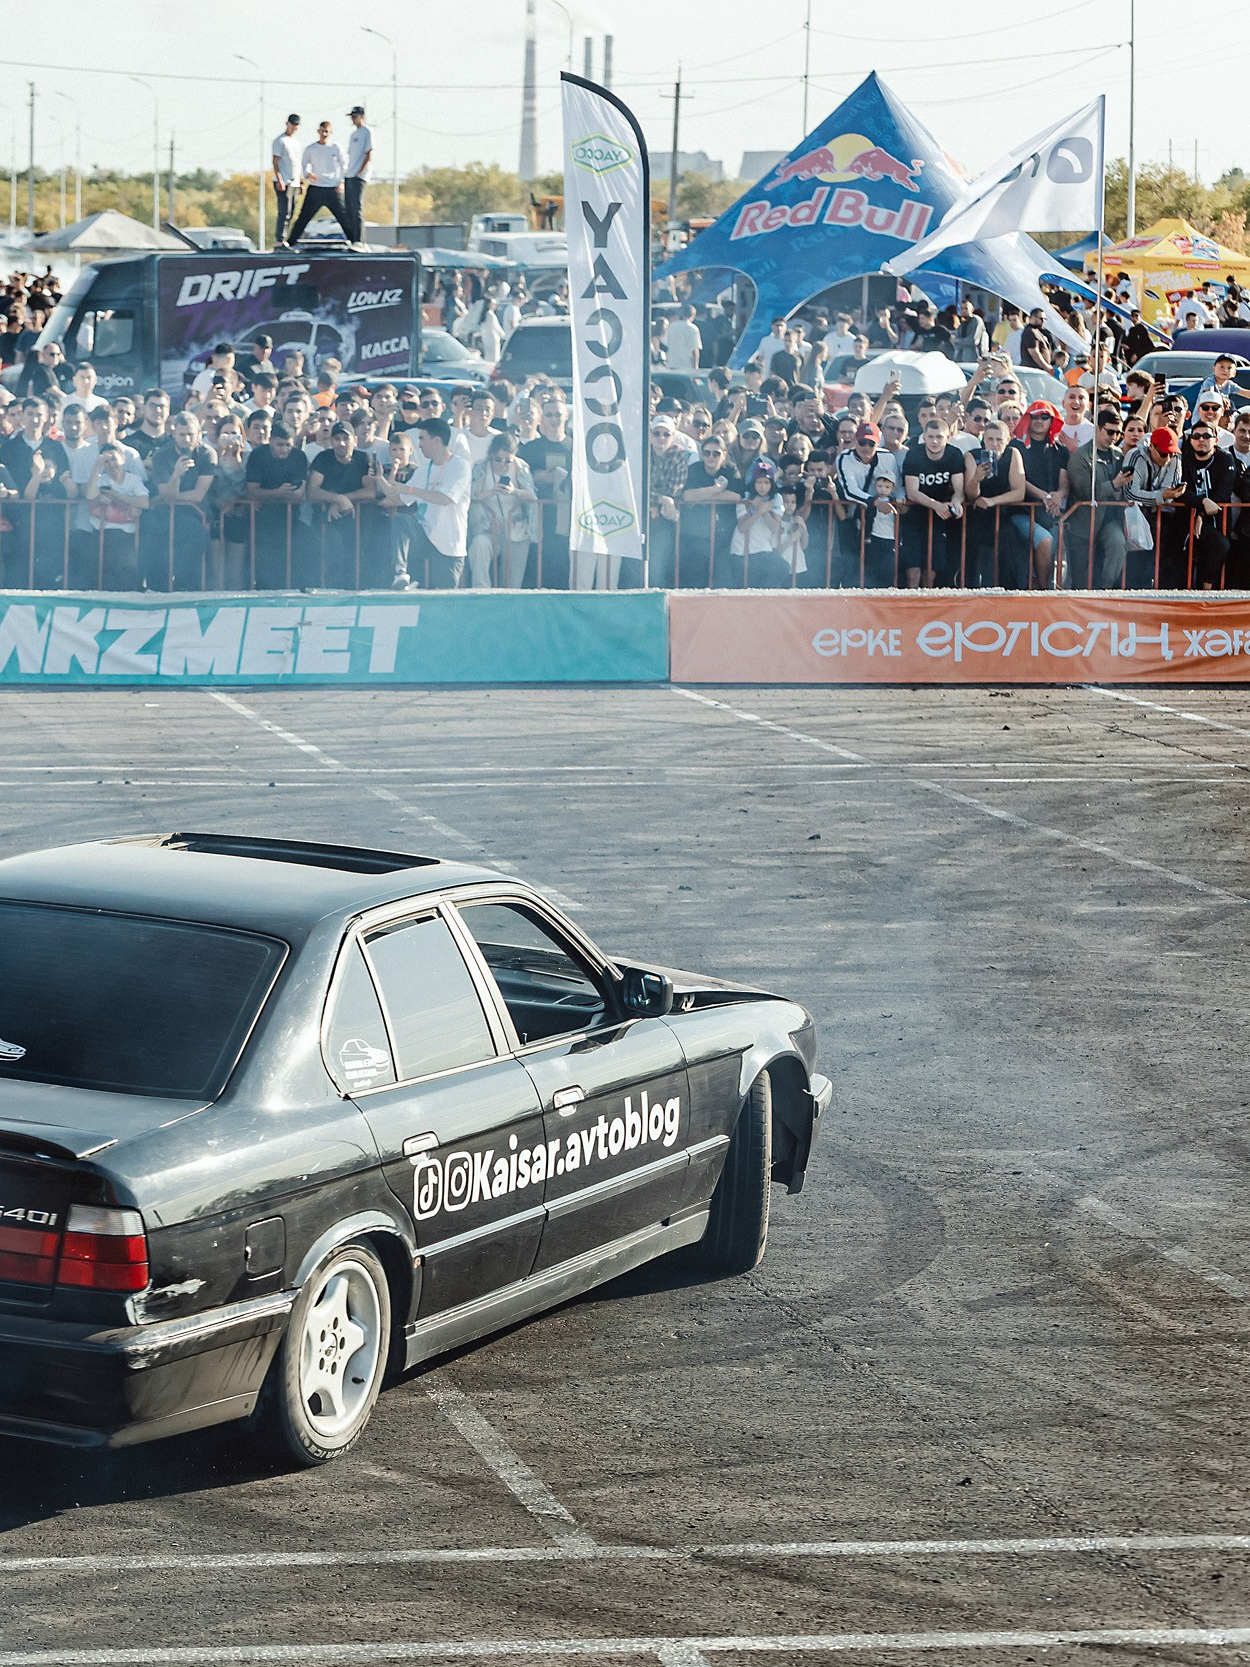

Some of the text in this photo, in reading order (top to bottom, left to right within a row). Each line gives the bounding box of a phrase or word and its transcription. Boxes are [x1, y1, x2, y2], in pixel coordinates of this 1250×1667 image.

[729, 187, 830, 240] Red
[823, 188, 934, 243] Bull
[176, 264, 310, 307] DRIFT
[918, 471, 950, 486] BOSS
[471, 1091, 680, 1203] Kaisar.avtoblog
